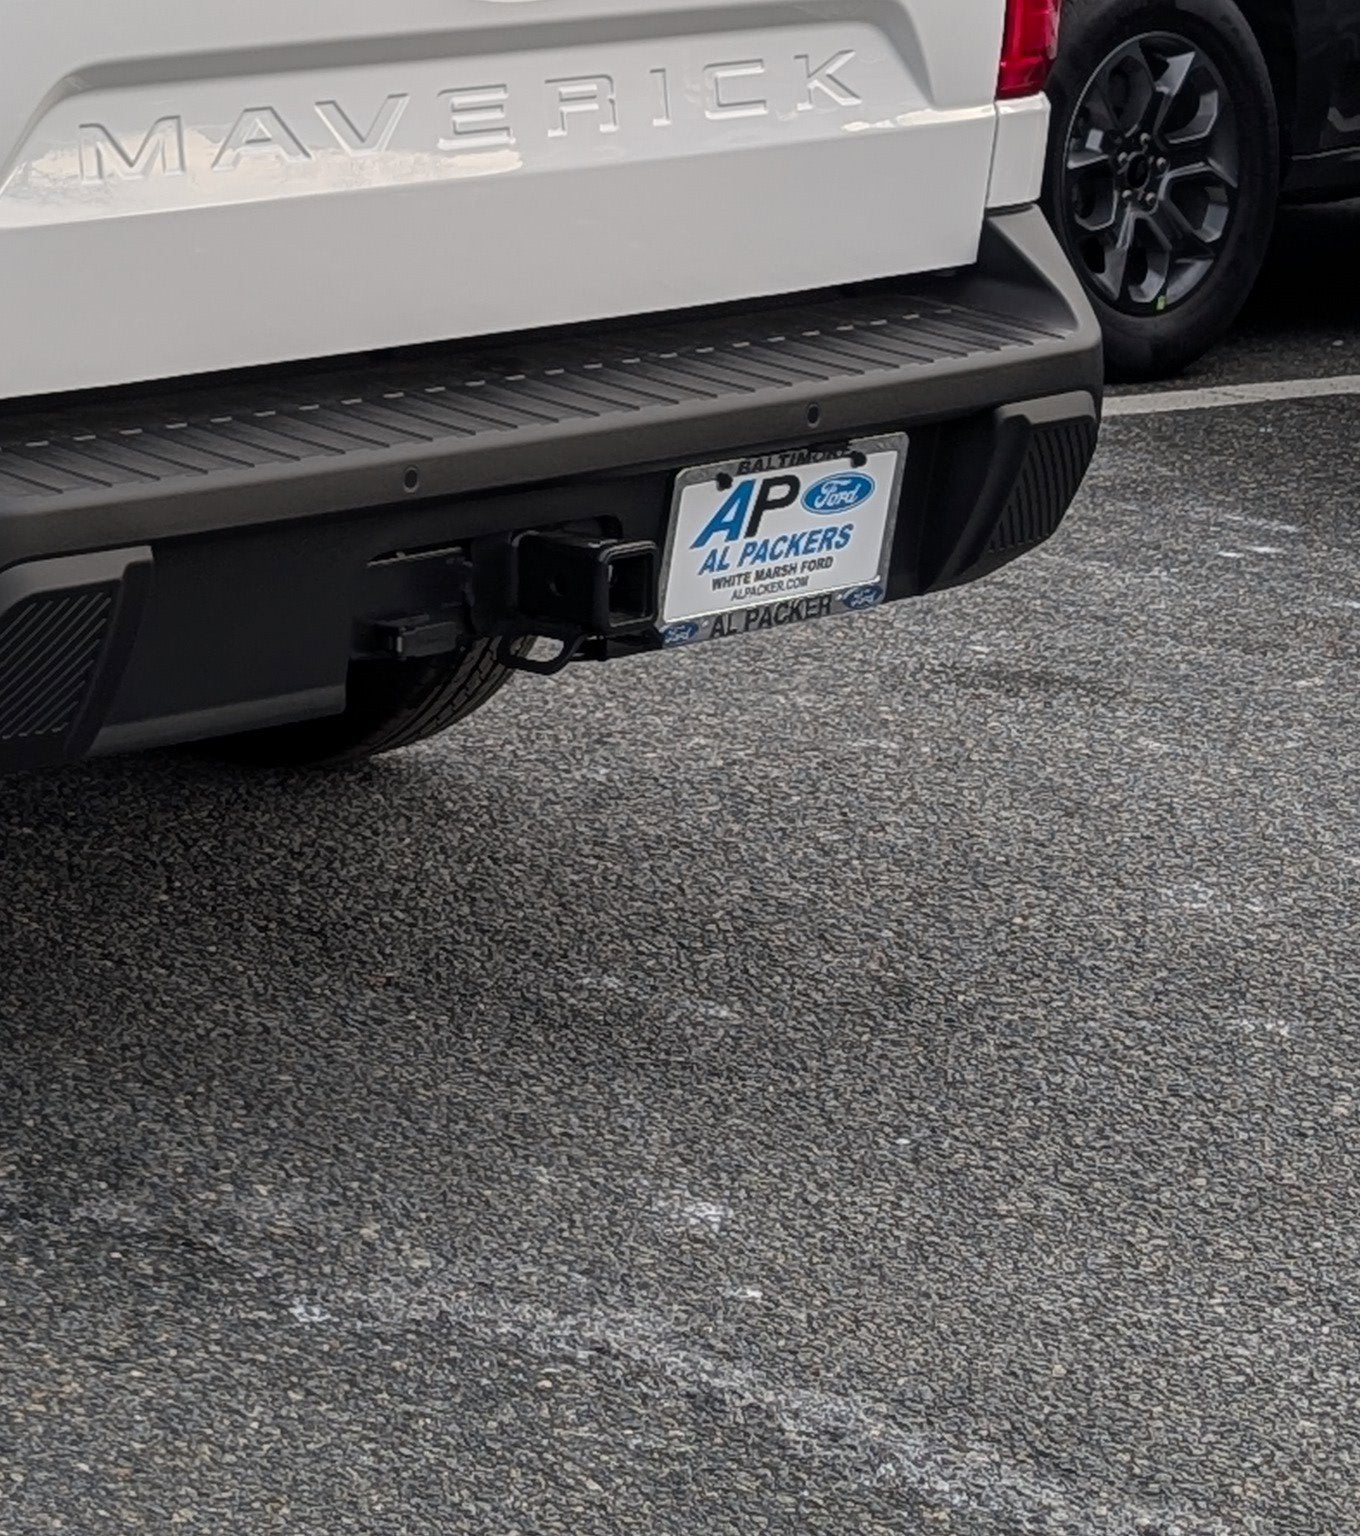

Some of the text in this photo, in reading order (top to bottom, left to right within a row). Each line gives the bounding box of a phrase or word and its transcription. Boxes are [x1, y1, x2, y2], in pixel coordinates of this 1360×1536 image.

[78, 47, 864, 188] MAVERICK
[689, 474, 801, 550] AP
[698, 523, 855, 576] AL PACKERS
[712, 556, 835, 592] WHITE MARSH FORD
[731, 576, 810, 601] ALPACKER.COM
[709, 594, 832, 639] AL PACKER
